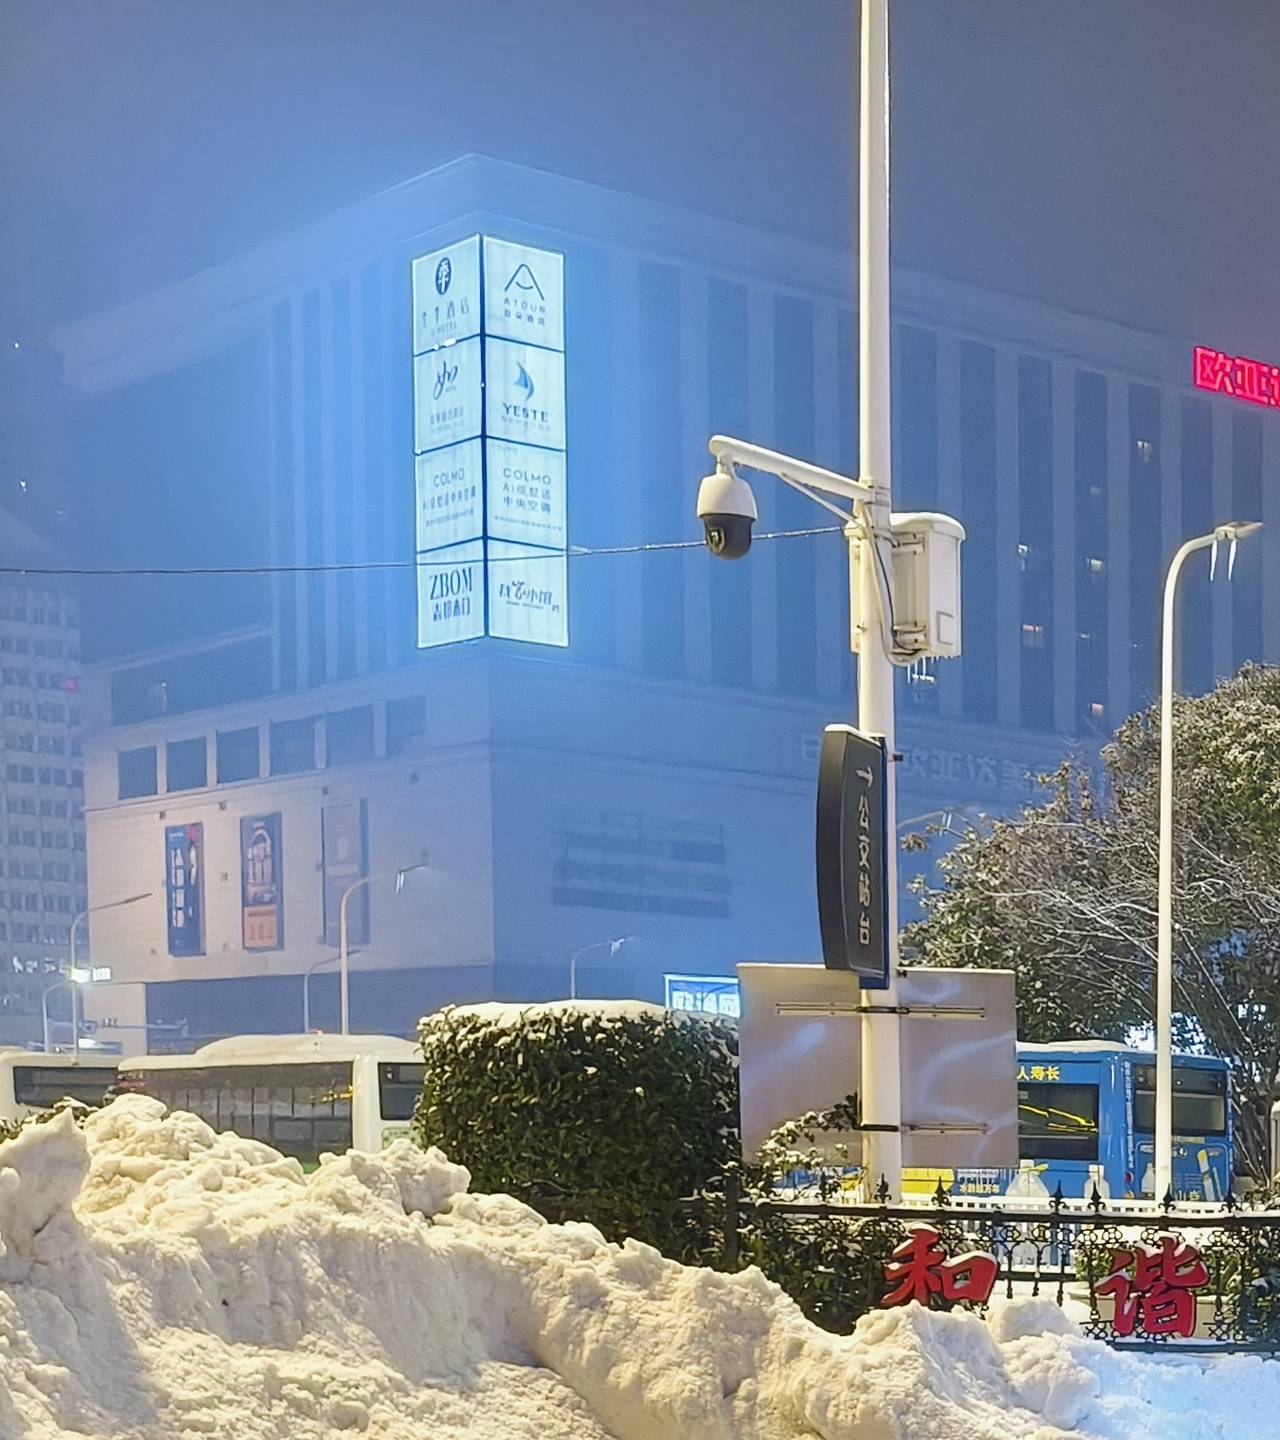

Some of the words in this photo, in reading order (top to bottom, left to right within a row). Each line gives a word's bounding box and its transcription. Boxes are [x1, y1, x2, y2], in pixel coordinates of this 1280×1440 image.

[502, 402, 549, 423] YESTE
[432, 467, 465, 488] COLMO
[503, 467, 552, 485] COLMO
[429, 566, 473, 600] ZBOM
